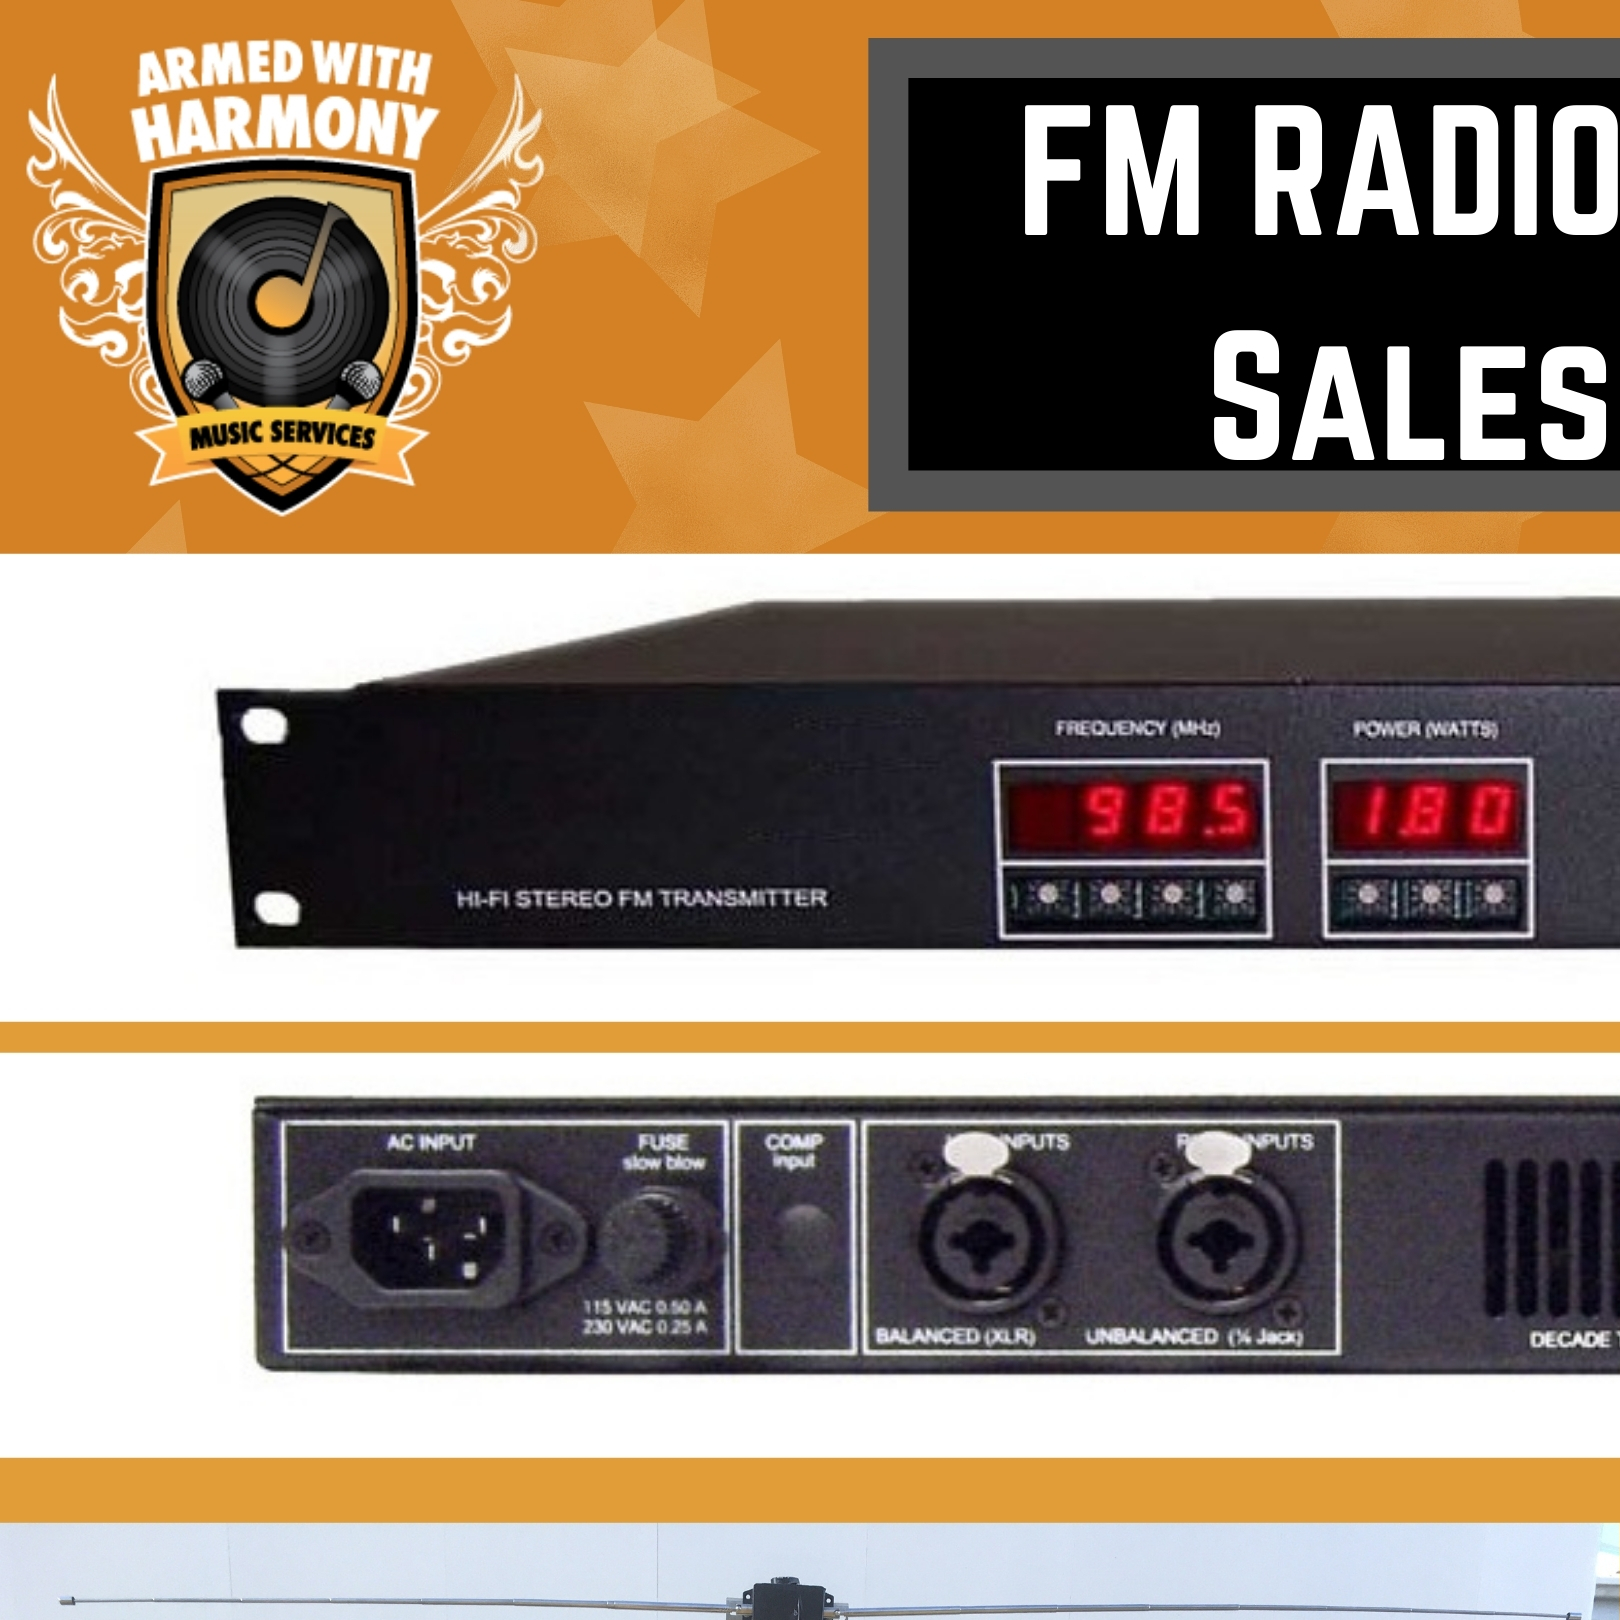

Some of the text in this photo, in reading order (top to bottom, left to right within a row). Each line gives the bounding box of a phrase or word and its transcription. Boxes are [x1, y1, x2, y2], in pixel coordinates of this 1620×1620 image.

[1056, 720, 1166, 736] FREQUENCY
[1354, 720, 1498, 739] POWER (WATTS)
[1086, 783, 1251, 836] 98.5
[457, 889, 827, 908] HI-FI STEREO FM TRANSMITTER
[388, 1134, 475, 1151] AC INPUT
[639, 1134, 688, 1151] FUSE
[765, 1133, 823, 1151] COMP
[1245, 1133, 1315, 1151] NPUTS
[623, 1154, 705, 1170] slow blow
[773, 1153, 815, 1171] input
[616, 1300, 651, 1314] VAC
[694, 1301, 707, 1313] A
[584, 1319, 613, 1334] 230
[617, 1319, 652, 1334] VAC
[696, 1320, 707, 1333] A
[875, 1327, 1036, 1347] BALANCED (XLR)
[1085, 1328, 1218, 1345] UNBALANCED
[1256, 1329, 1303, 1347] Jack)
[1530, 1331, 1610, 1348] DECADE
